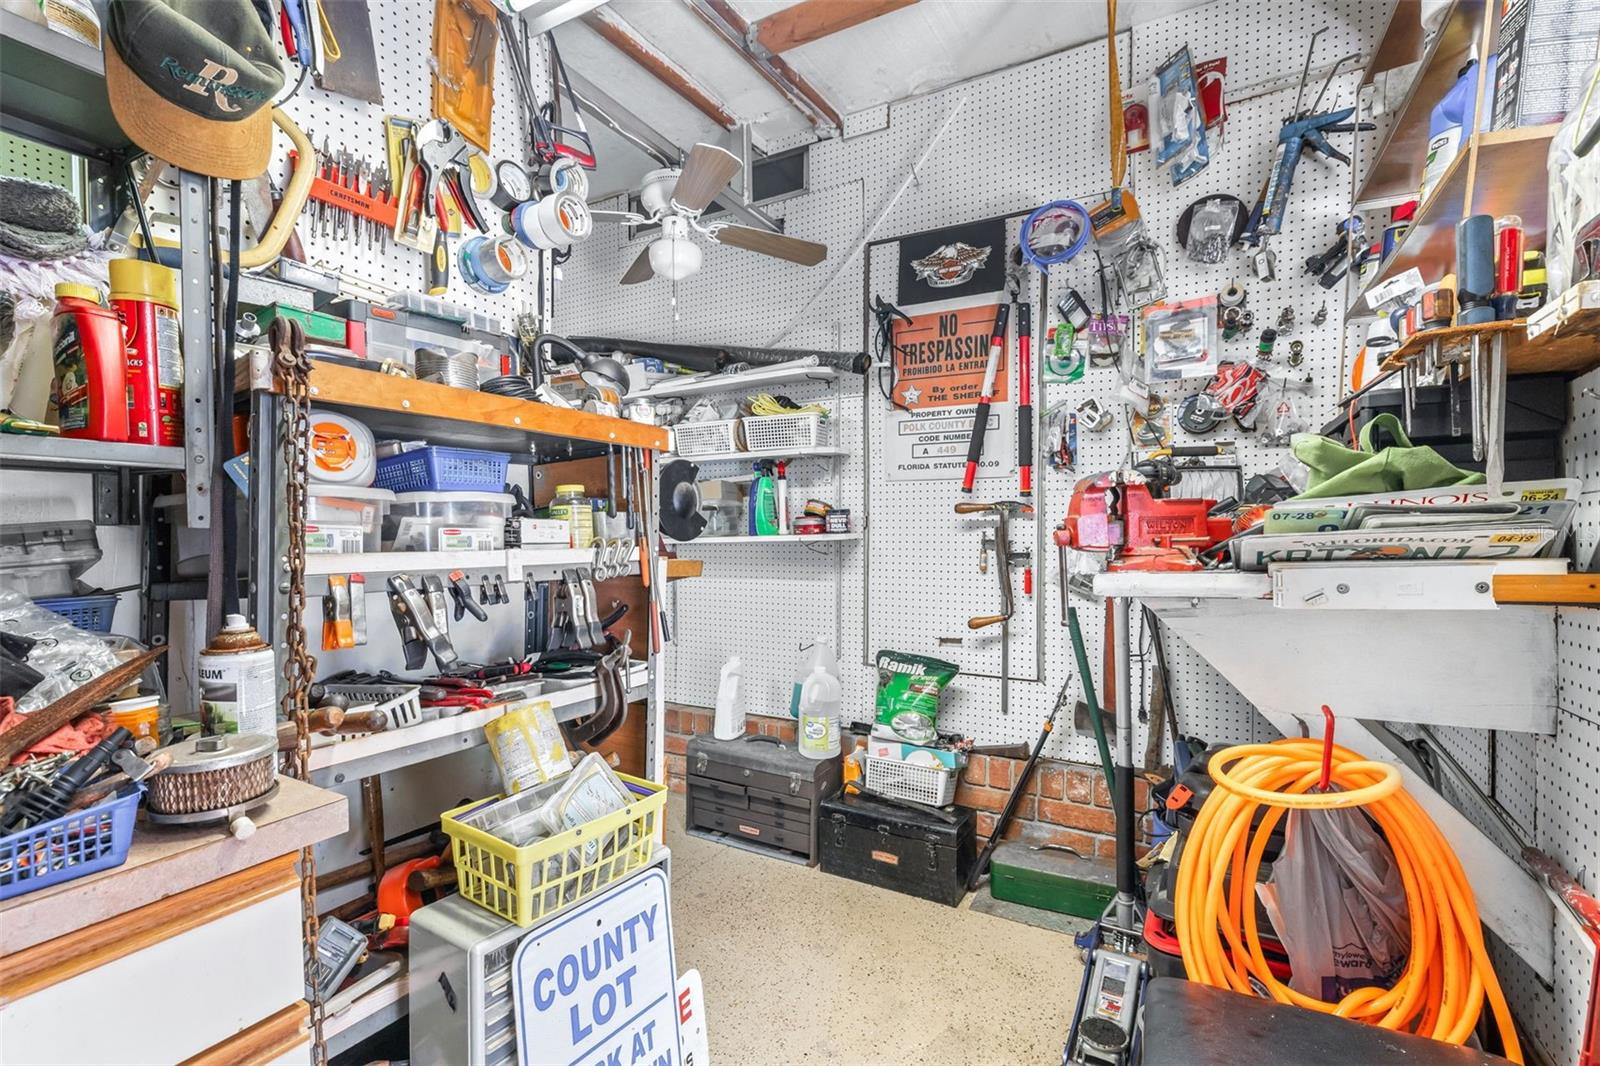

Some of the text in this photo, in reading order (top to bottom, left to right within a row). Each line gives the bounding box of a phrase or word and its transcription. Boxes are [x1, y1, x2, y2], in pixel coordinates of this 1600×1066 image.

[183, 58, 242, 113] R
[329, 189, 370, 209] CRAFTSMAN
[938, 313, 958, 338] NO
[901, 334, 990, 366] TRESPASSIN
[902, 360, 988, 377] PROHIBIDO LA ENTRA
[932, 383, 978, 393] By order
[928, 394, 948, 402] THE
[911, 408, 978, 419] PROPERTY OWN
[903, 422, 927, 433] POLK
[928, 419, 967, 431] COUNTY
[937, 445, 957, 454] 449
[933, 461, 967, 469] STATUTE
[1521, 493, 1559, 501] 06-24
[1272, 511, 1314, 521] 07-28
[1145, 520, 1187, 530] WILTON
[1497, 535, 1534, 543] 04-19
[878, 656, 927, 676] Ramik
[533, 903, 658, 1012] COUNTY
[570, 965, 637, 1046] LOT
[631, 1019, 656, 1066] AT
